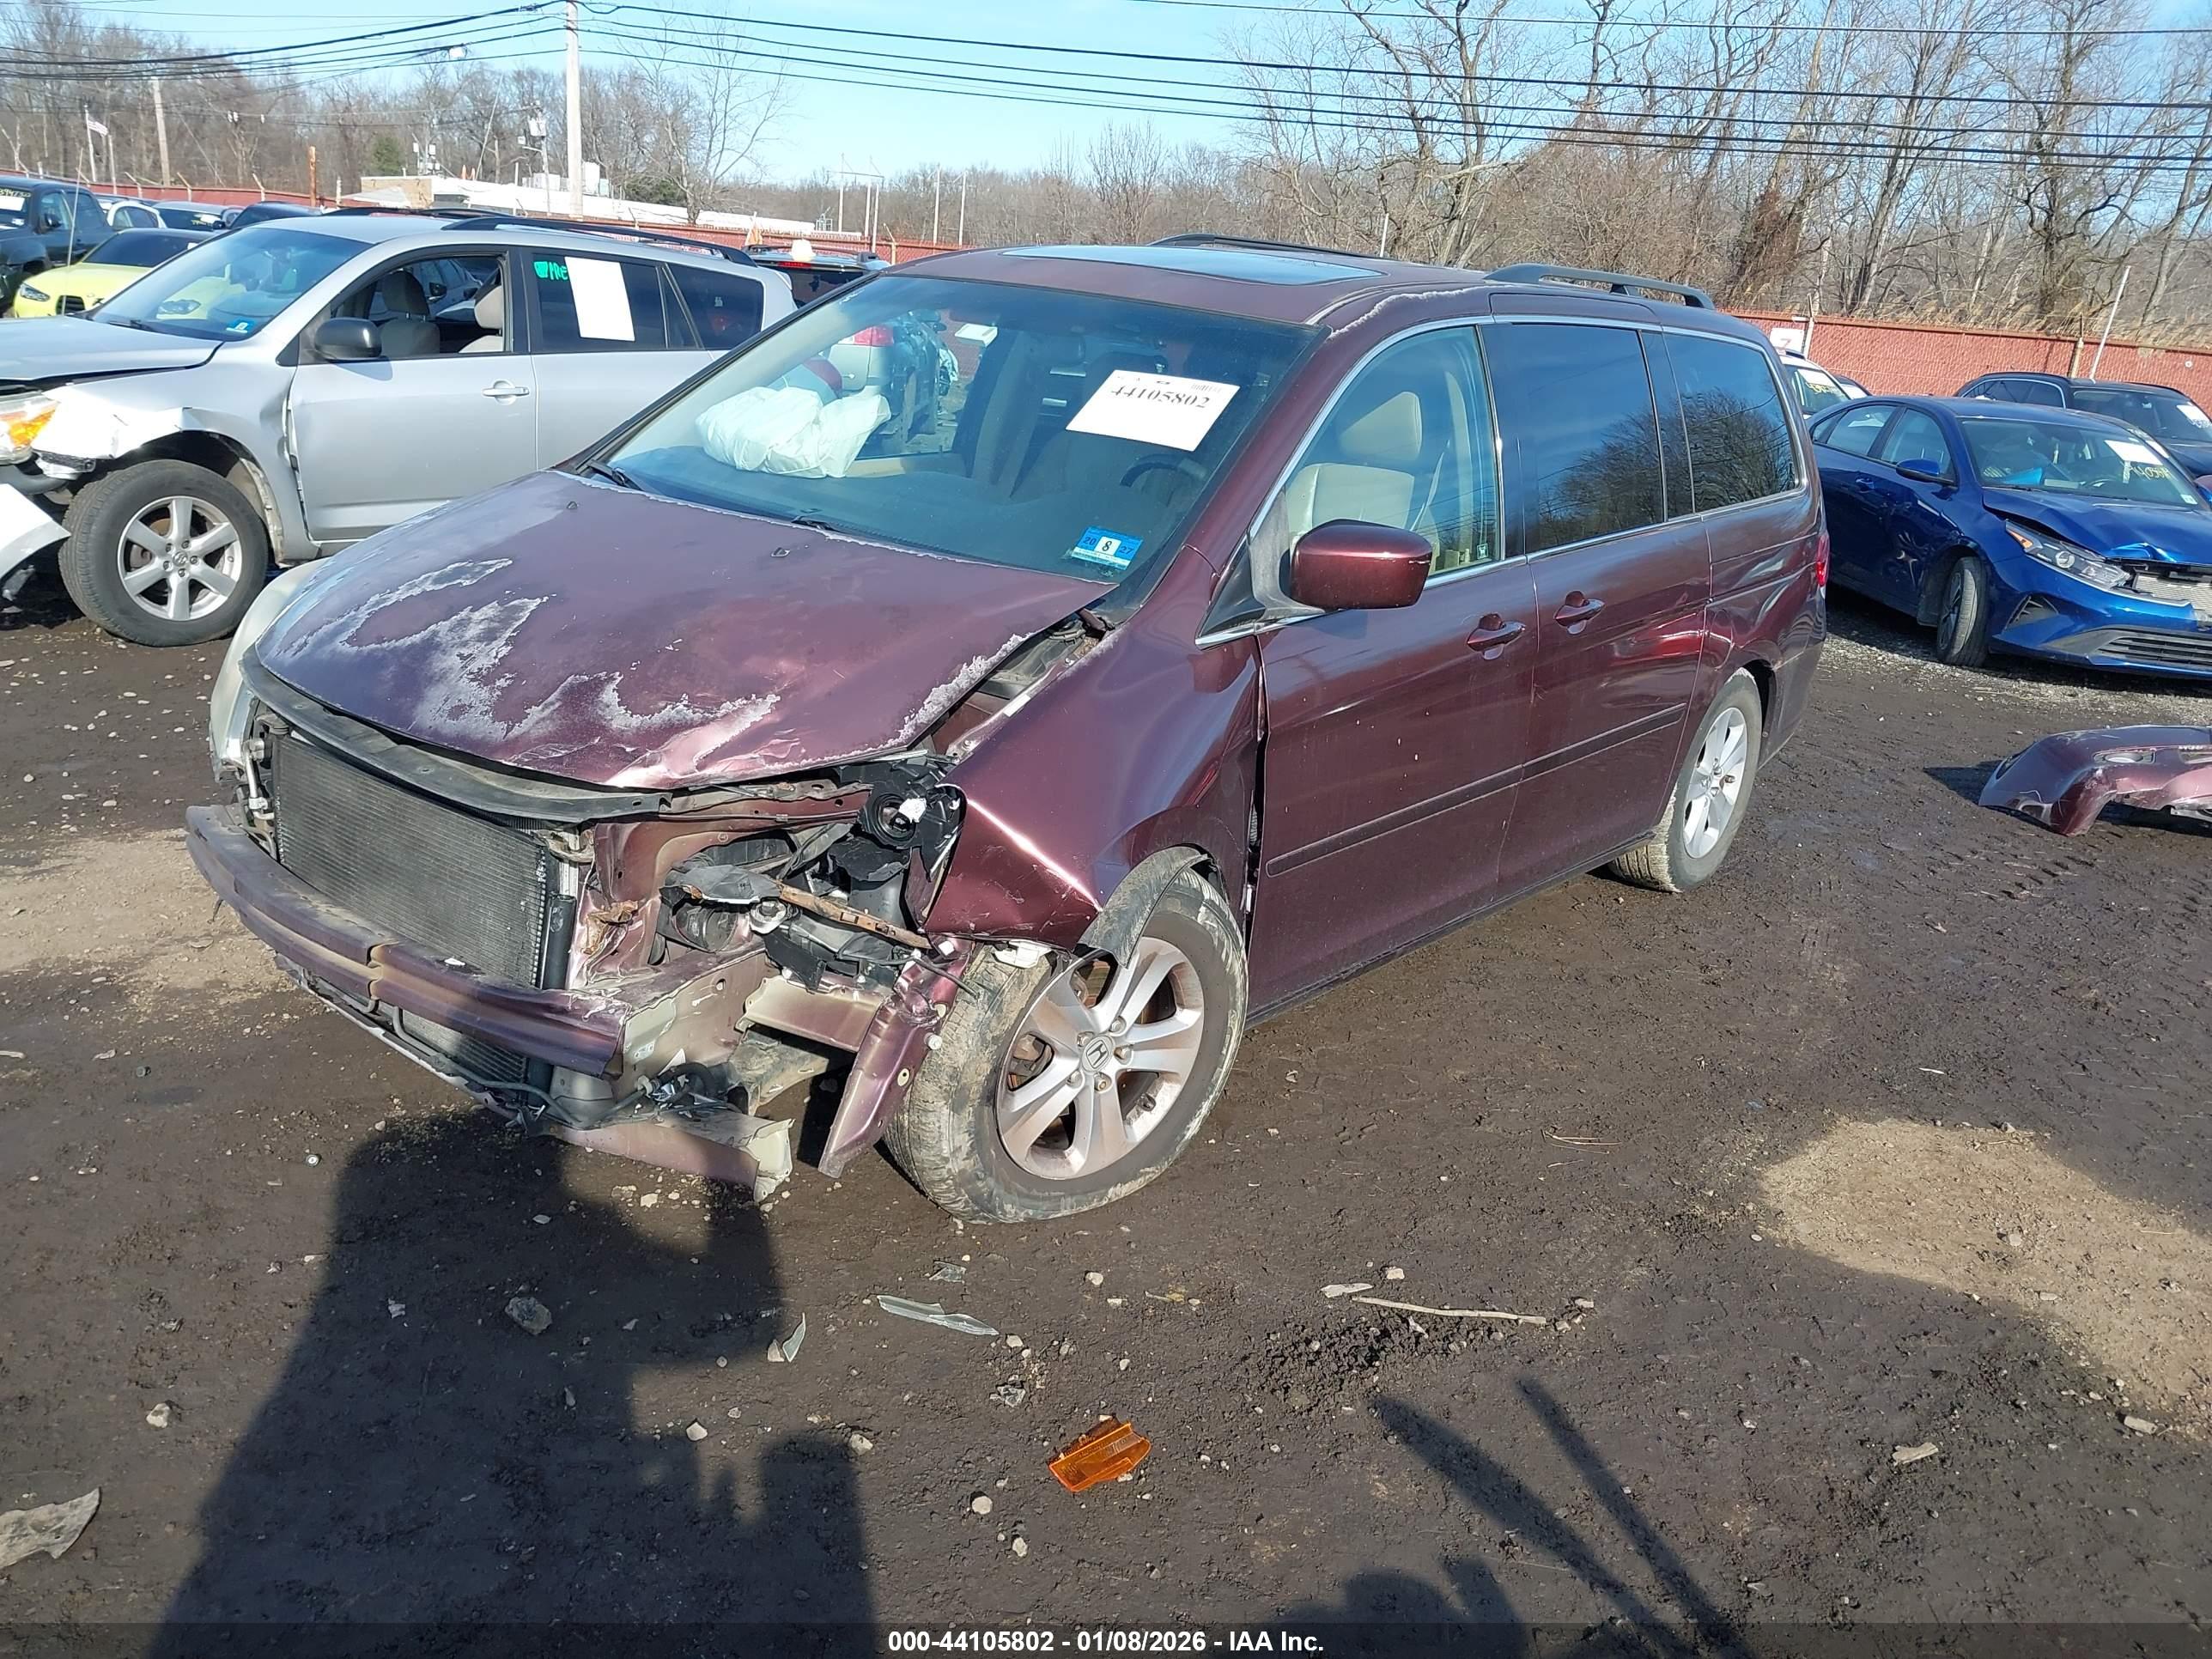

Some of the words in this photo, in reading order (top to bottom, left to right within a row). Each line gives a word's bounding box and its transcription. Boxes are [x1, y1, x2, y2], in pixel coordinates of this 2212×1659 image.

[1111, 385, 1211, 408] 44105802
[1083, 537, 1097, 545] 20
[1102, 540, 1113, 552] 8
[1119, 545, 1134, 555] 27
